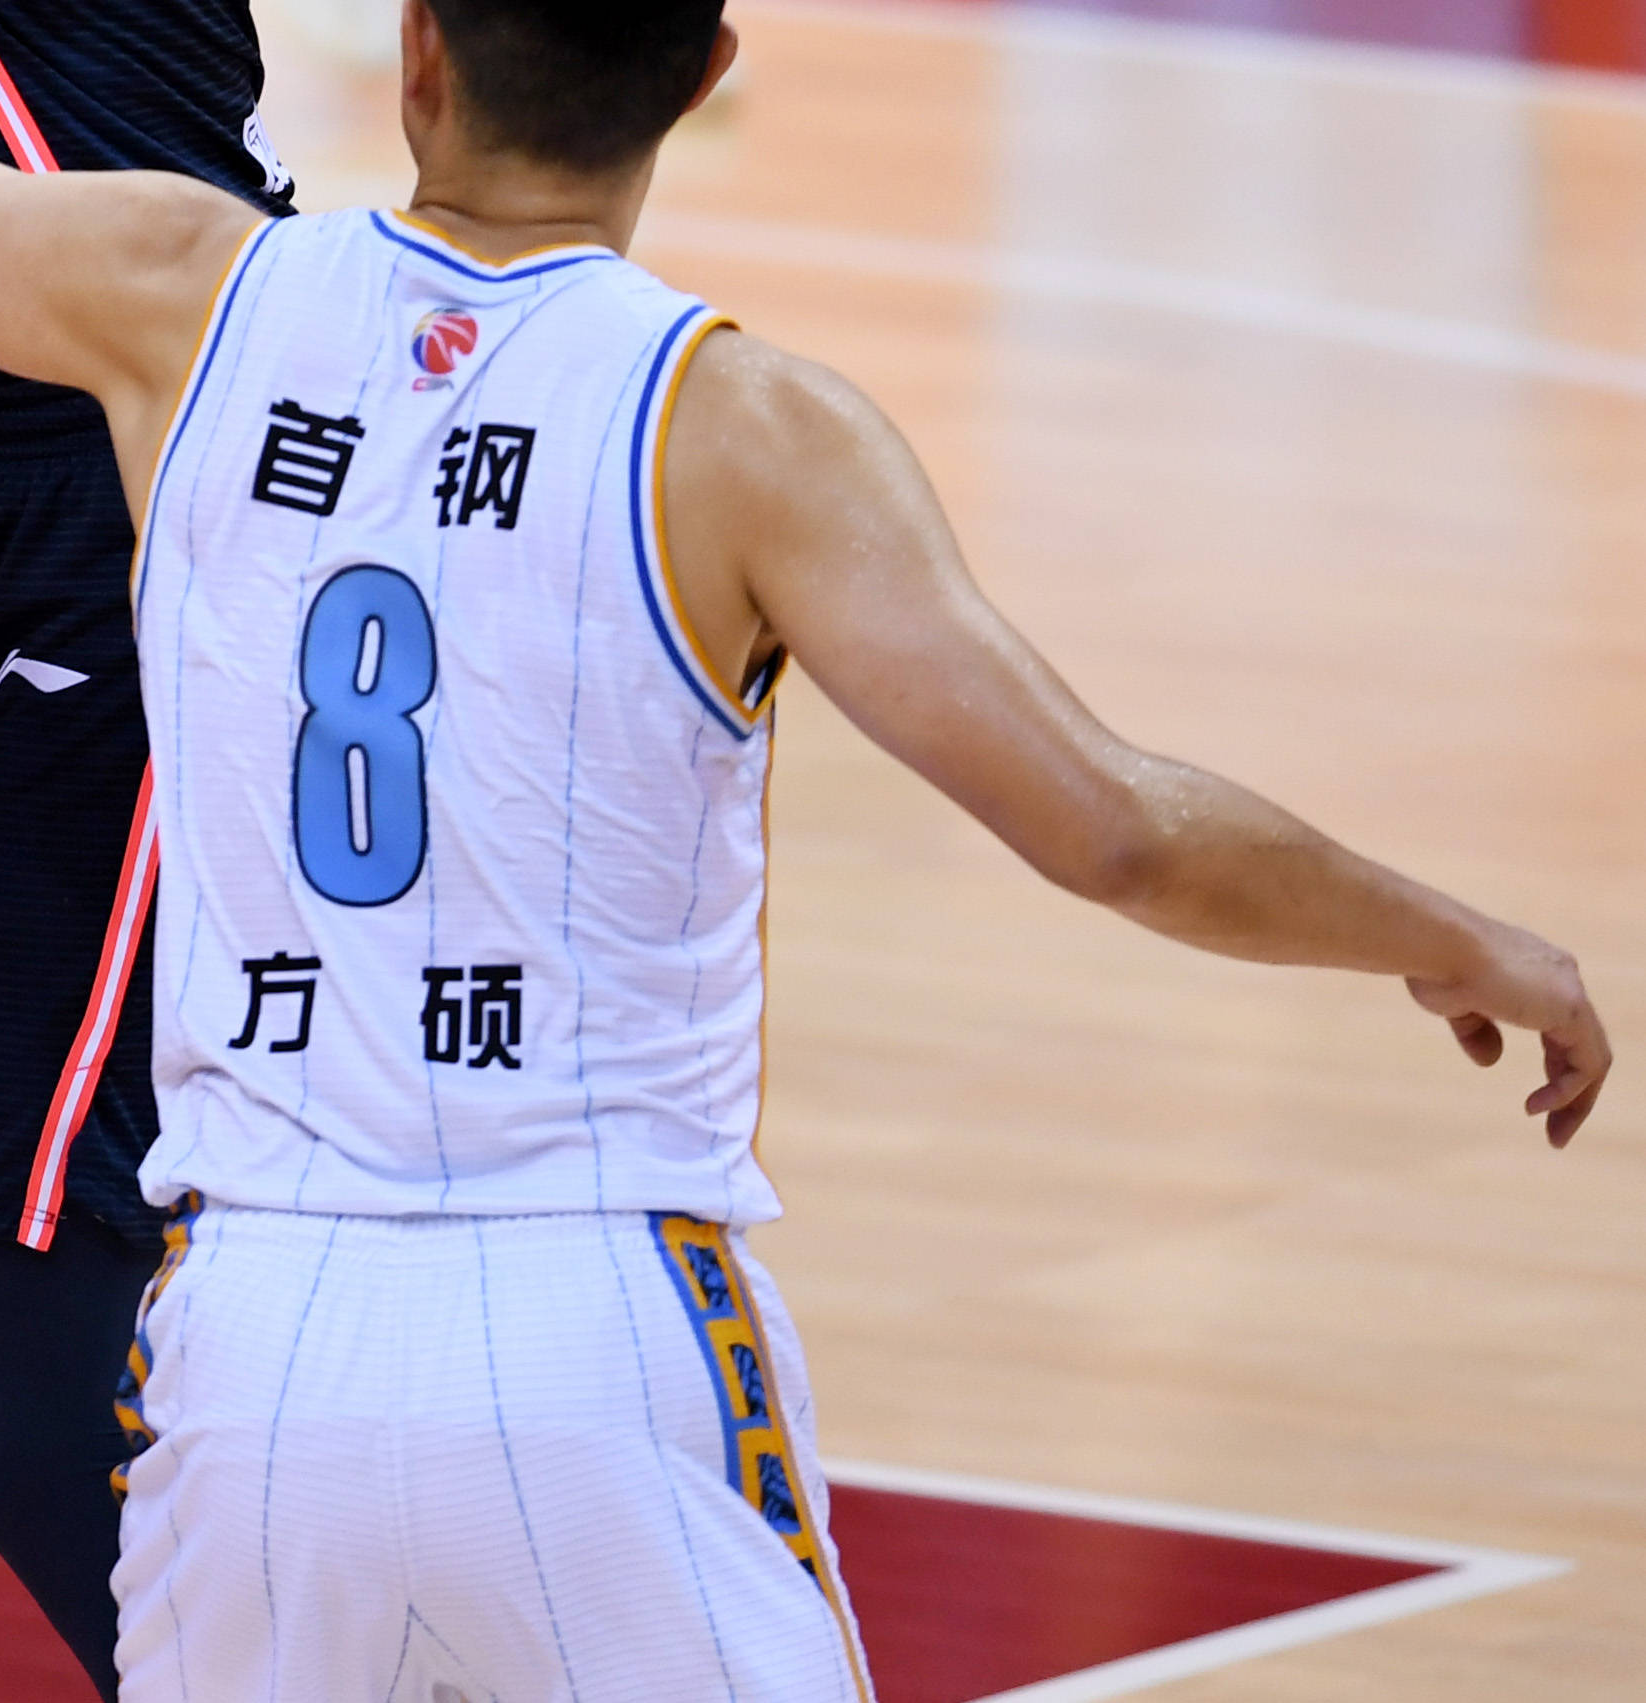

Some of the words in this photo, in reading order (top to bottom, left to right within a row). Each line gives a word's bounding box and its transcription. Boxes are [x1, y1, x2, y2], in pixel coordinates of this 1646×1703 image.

[252, 398, 537, 531] 首钢
[293, 563, 437, 908] 8
[226, 951, 523, 1070] 方硕
